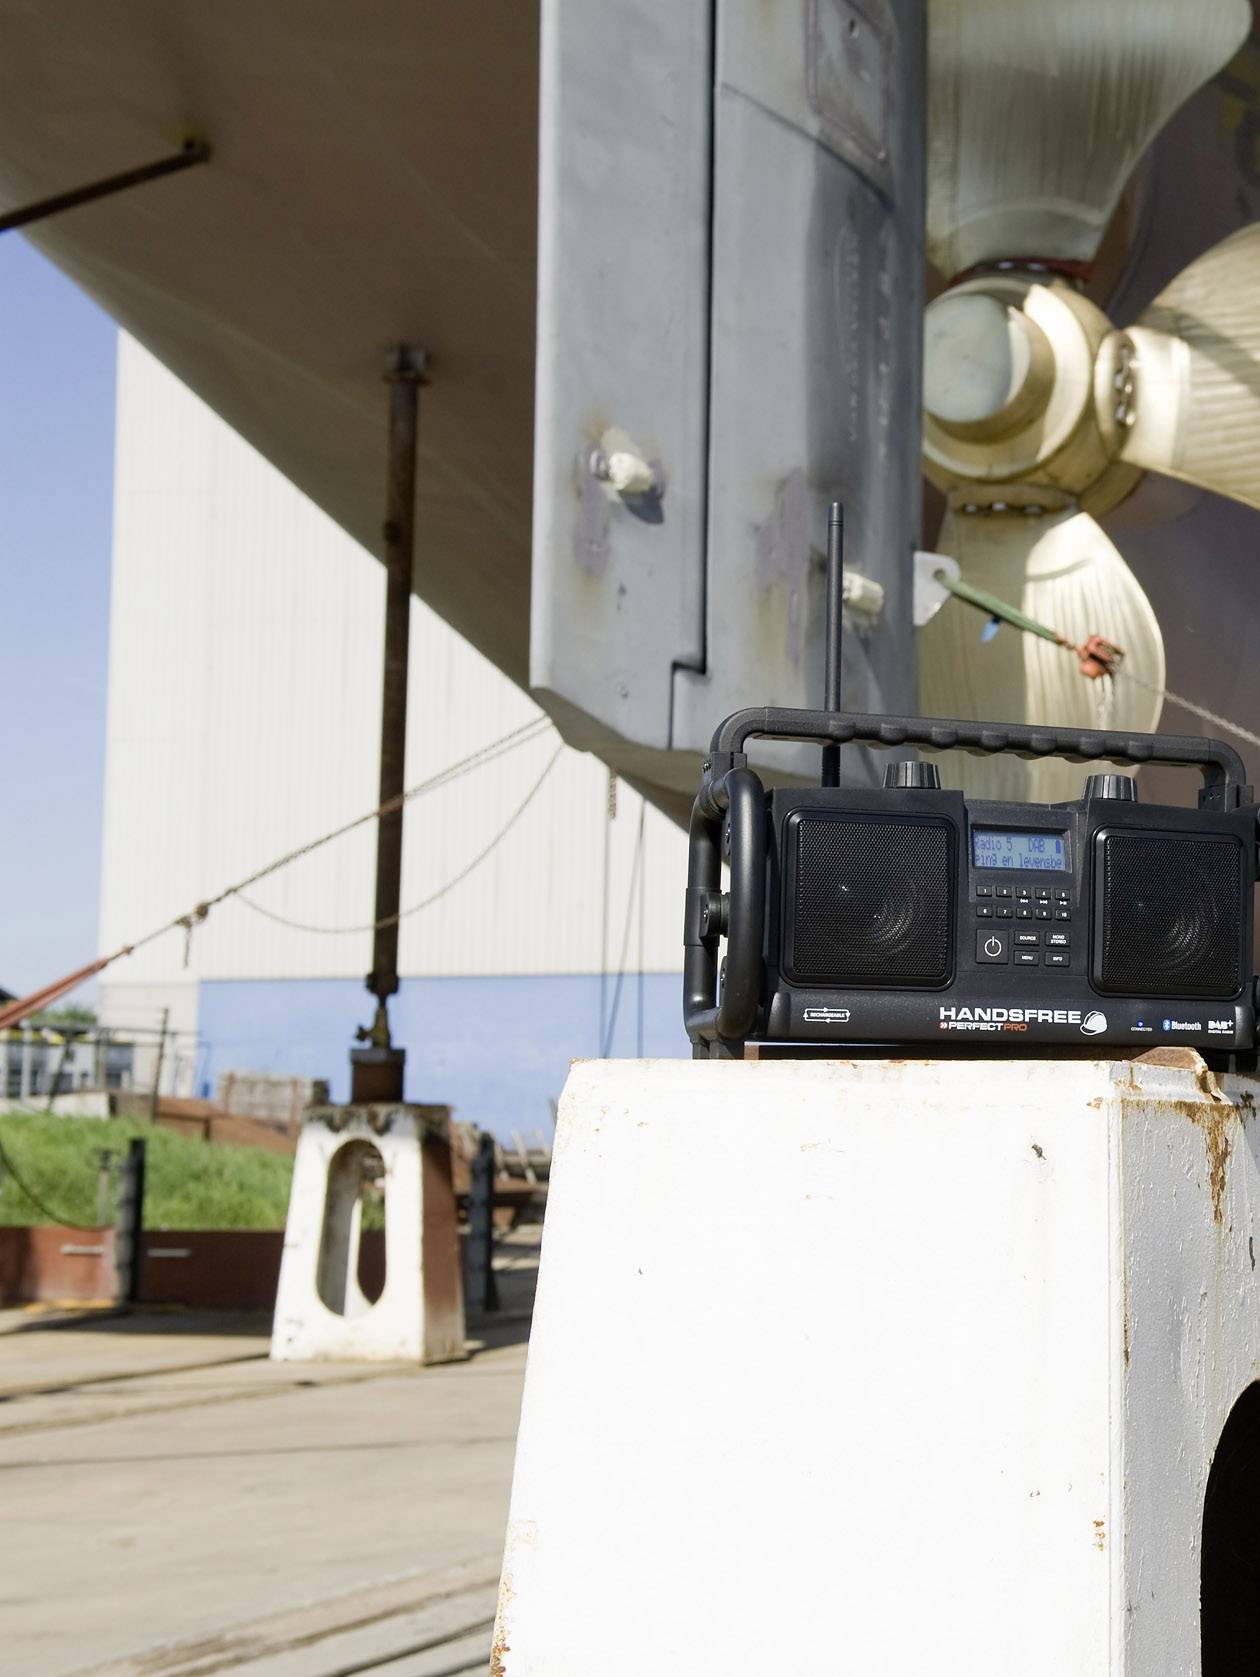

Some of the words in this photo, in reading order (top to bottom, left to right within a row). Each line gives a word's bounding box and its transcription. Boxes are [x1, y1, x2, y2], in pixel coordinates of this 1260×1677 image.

[1006, 834, 1013, 852] 5
[1028, 837, 1046, 854] DAB
[939, 1006, 1082, 1024] HANDSFREE
[1171, 1020, 1202, 1031] Bluetooth
[1207, 1019, 1234, 1030] DAB+
